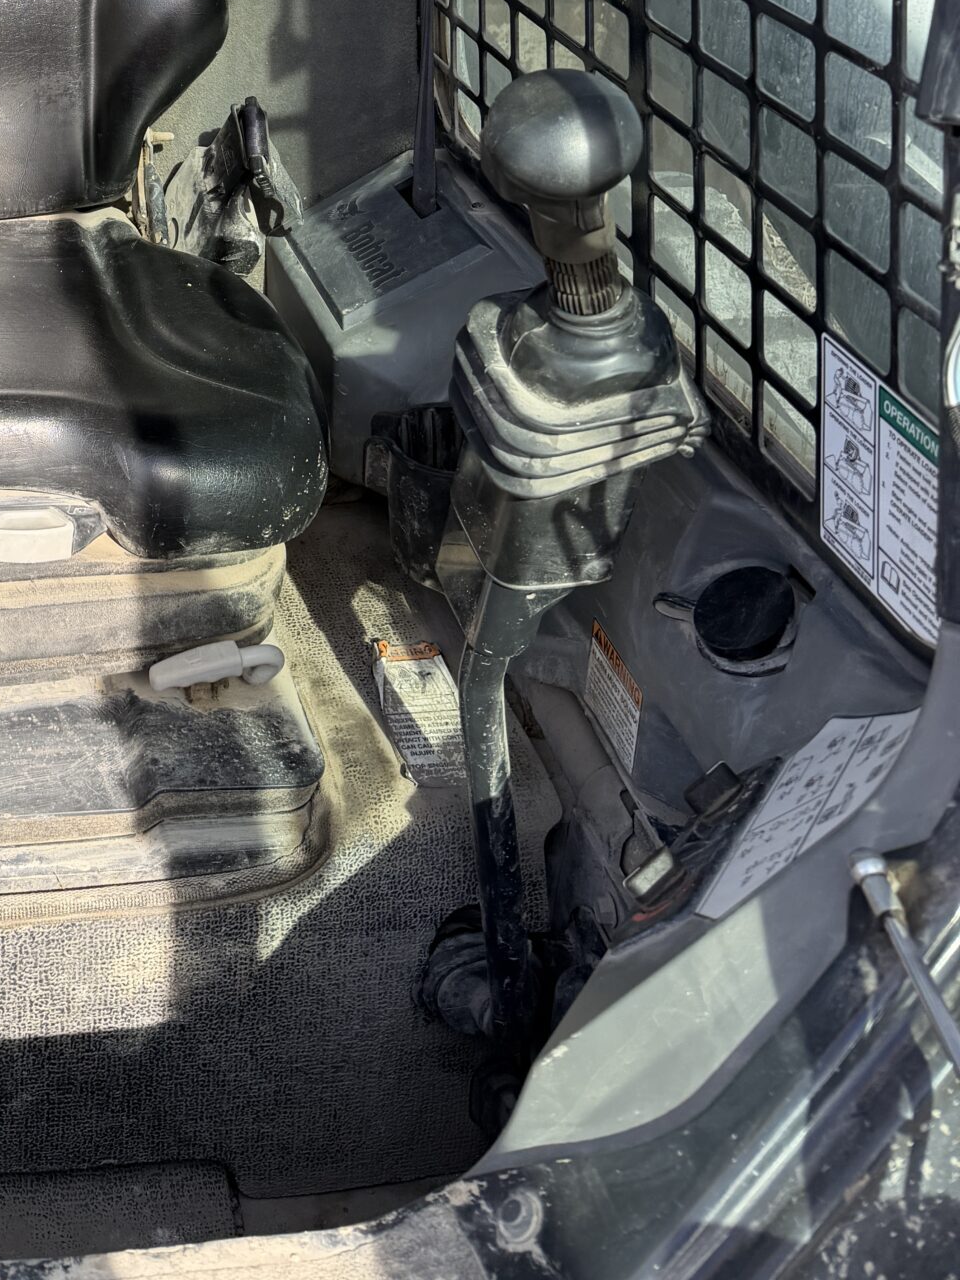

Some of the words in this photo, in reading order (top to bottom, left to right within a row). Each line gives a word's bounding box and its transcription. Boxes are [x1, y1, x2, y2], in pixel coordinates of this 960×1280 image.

[340, 220, 408, 291] Bobcat
[856, 371, 873, 390] LOADER
[857, 437, 873, 455] LOADER
[883, 400, 939, 458] OPERATION
[888, 429, 897, 441] TO
[896, 437, 921, 465] OPERATE
[921, 460, 938, 478] LOAD
[600, 633, 641, 705] WARNING
